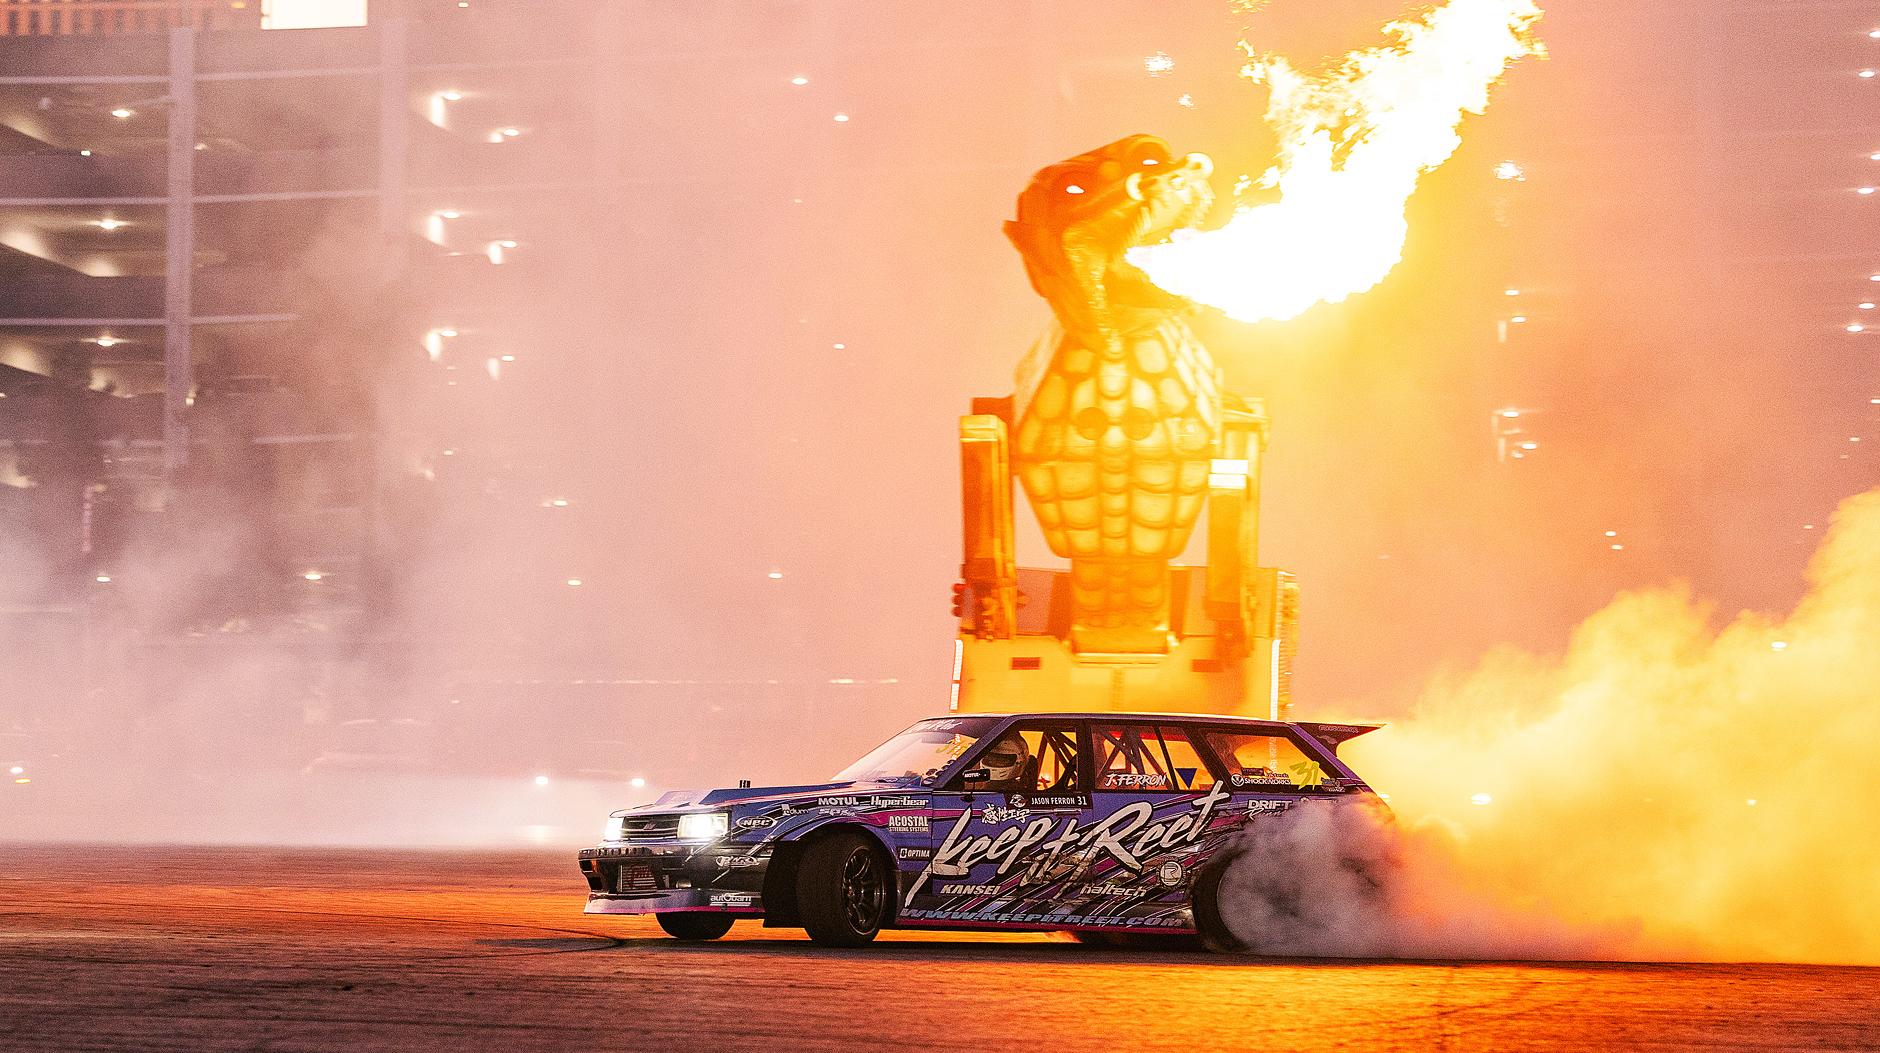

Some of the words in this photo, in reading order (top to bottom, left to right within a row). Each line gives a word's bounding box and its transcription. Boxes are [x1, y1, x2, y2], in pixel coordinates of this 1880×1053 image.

[818, 797, 860, 806] MOTUL
[1031, 796, 1050, 805] JASON
[1051, 796, 1075, 805] FERRON
[1077, 796, 1087, 806] 31
[1248, 800, 1293, 810] DRIFT
[889, 815, 929, 827] ACOSTAL
[907, 849, 930, 858] OPTIMA
[940, 884, 1001, 895] KANSEI
[1080, 884, 1147, 897] haltech
